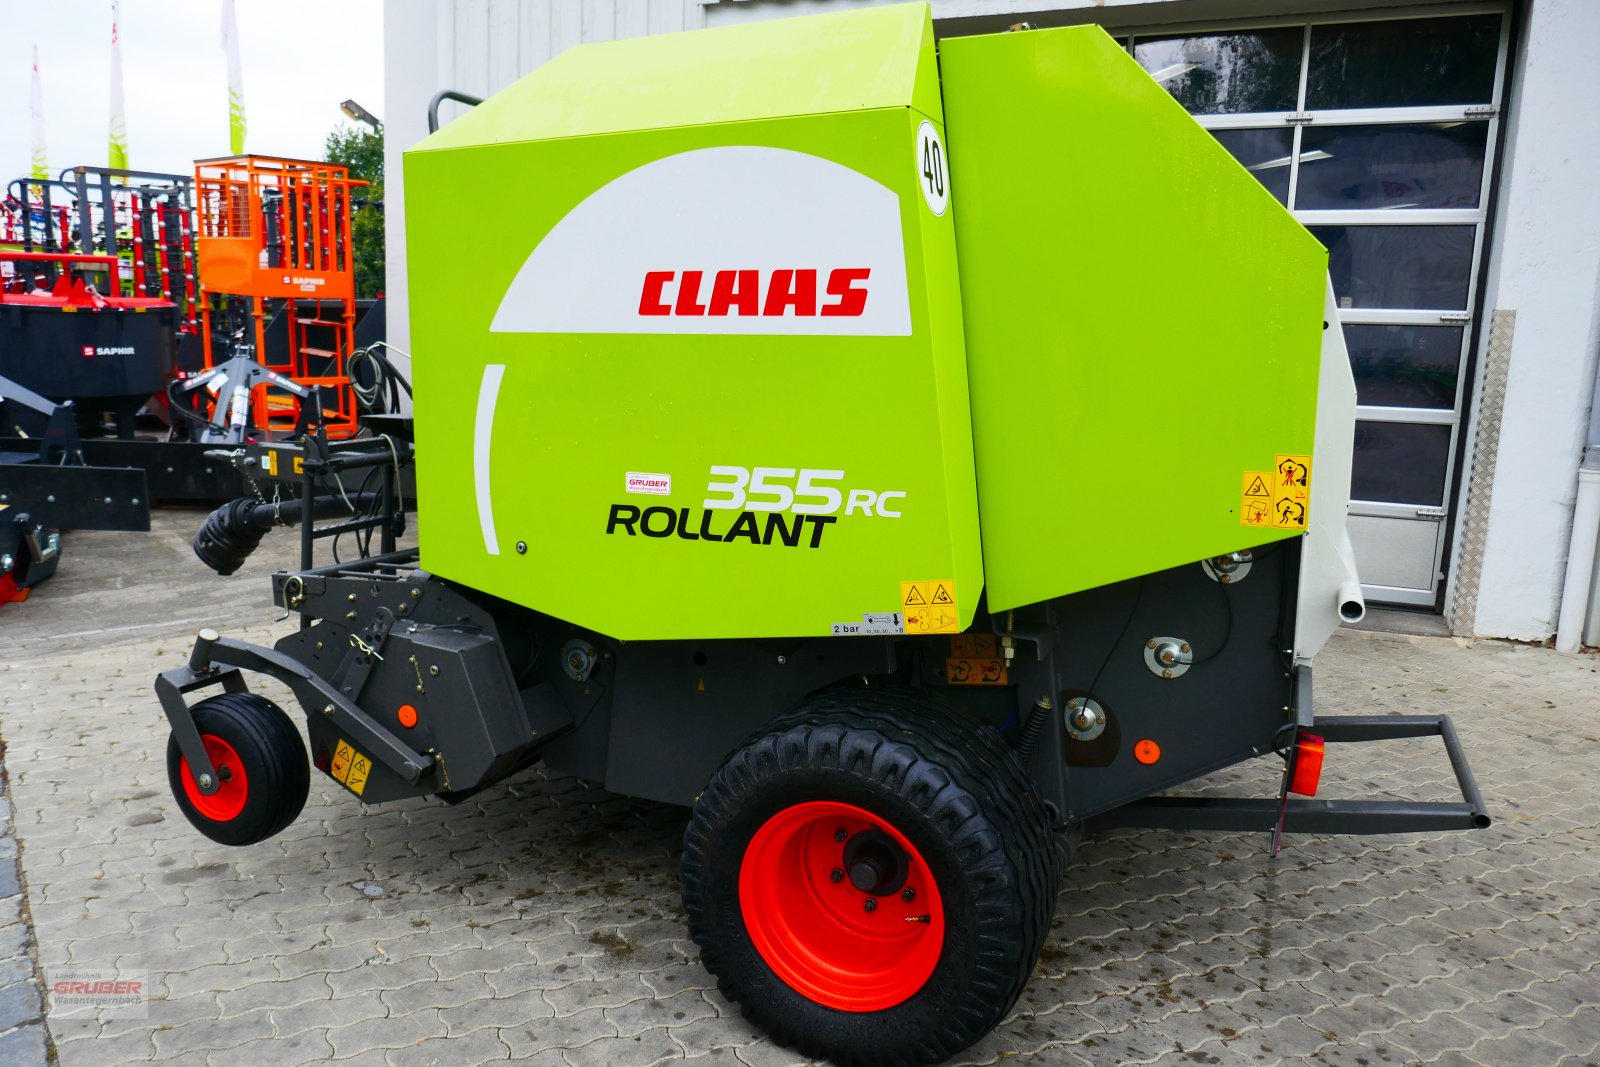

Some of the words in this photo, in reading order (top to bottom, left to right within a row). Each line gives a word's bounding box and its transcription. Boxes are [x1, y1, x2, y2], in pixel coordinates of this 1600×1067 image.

[923, 136, 944, 198] 40
[292, 277, 325, 286] SAPHIR
[638, 268, 871, 317] CLAAS
[96, 346, 135, 356] SAPHIR
[629, 478, 668, 488] GRUBER
[703, 465, 845, 515] 355
[845, 489, 907, 518] RC
[606, 503, 838, 549] ROLLANT
[834, 625, 840, 633] 2
[843, 624, 860, 633] bar
